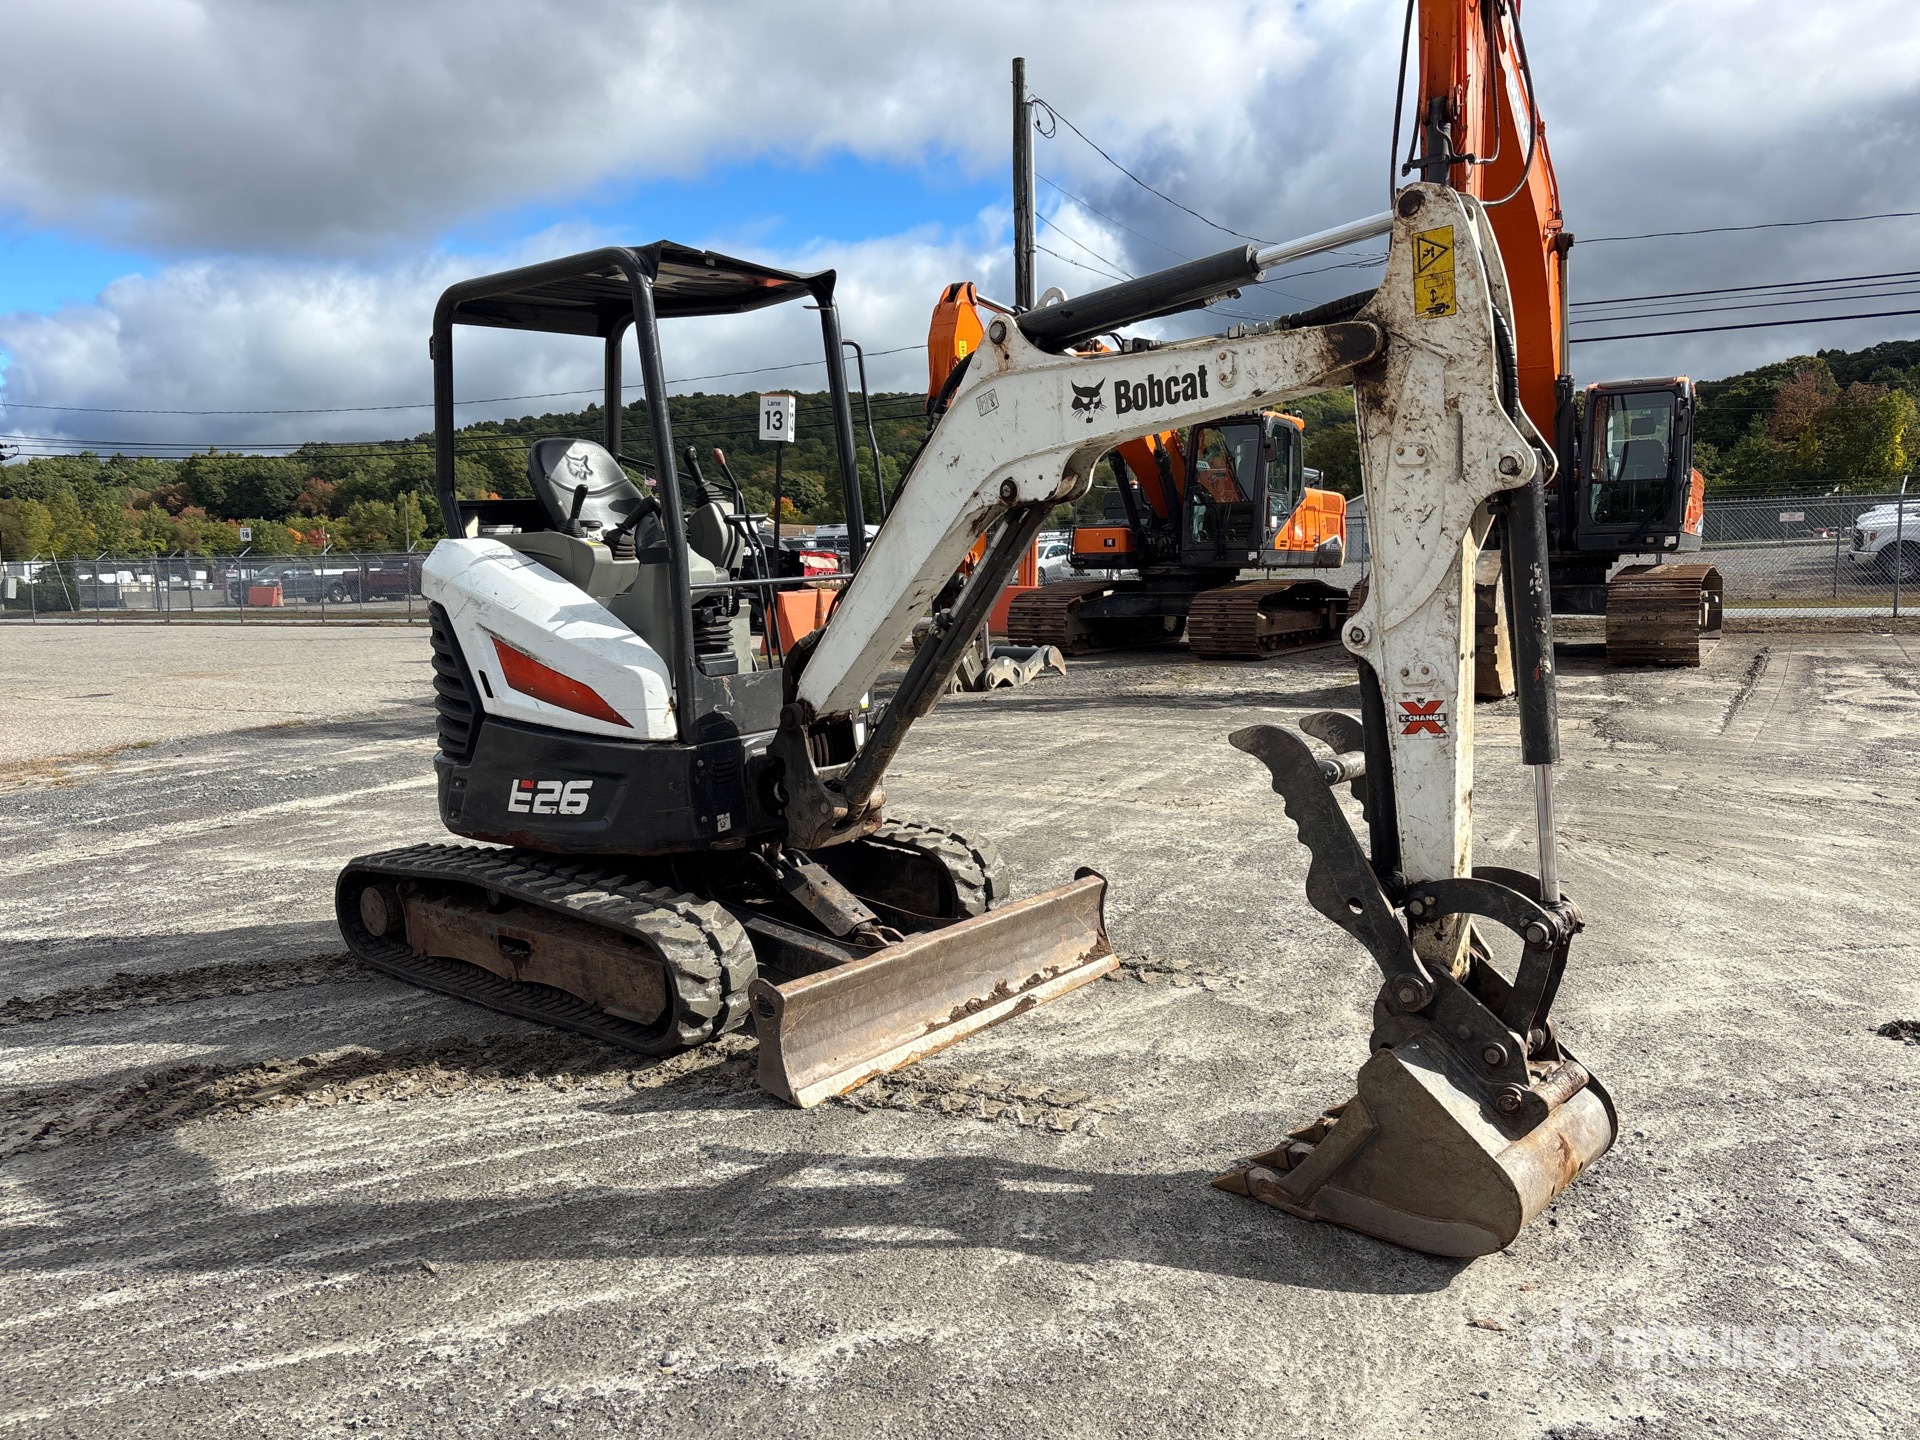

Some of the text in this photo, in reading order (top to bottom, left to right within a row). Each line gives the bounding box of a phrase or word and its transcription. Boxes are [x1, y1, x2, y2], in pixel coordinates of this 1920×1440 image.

[1114, 365, 1209, 415] Bobcat
[765, 410, 783, 430] 13
[507, 778, 594, 815] E26
